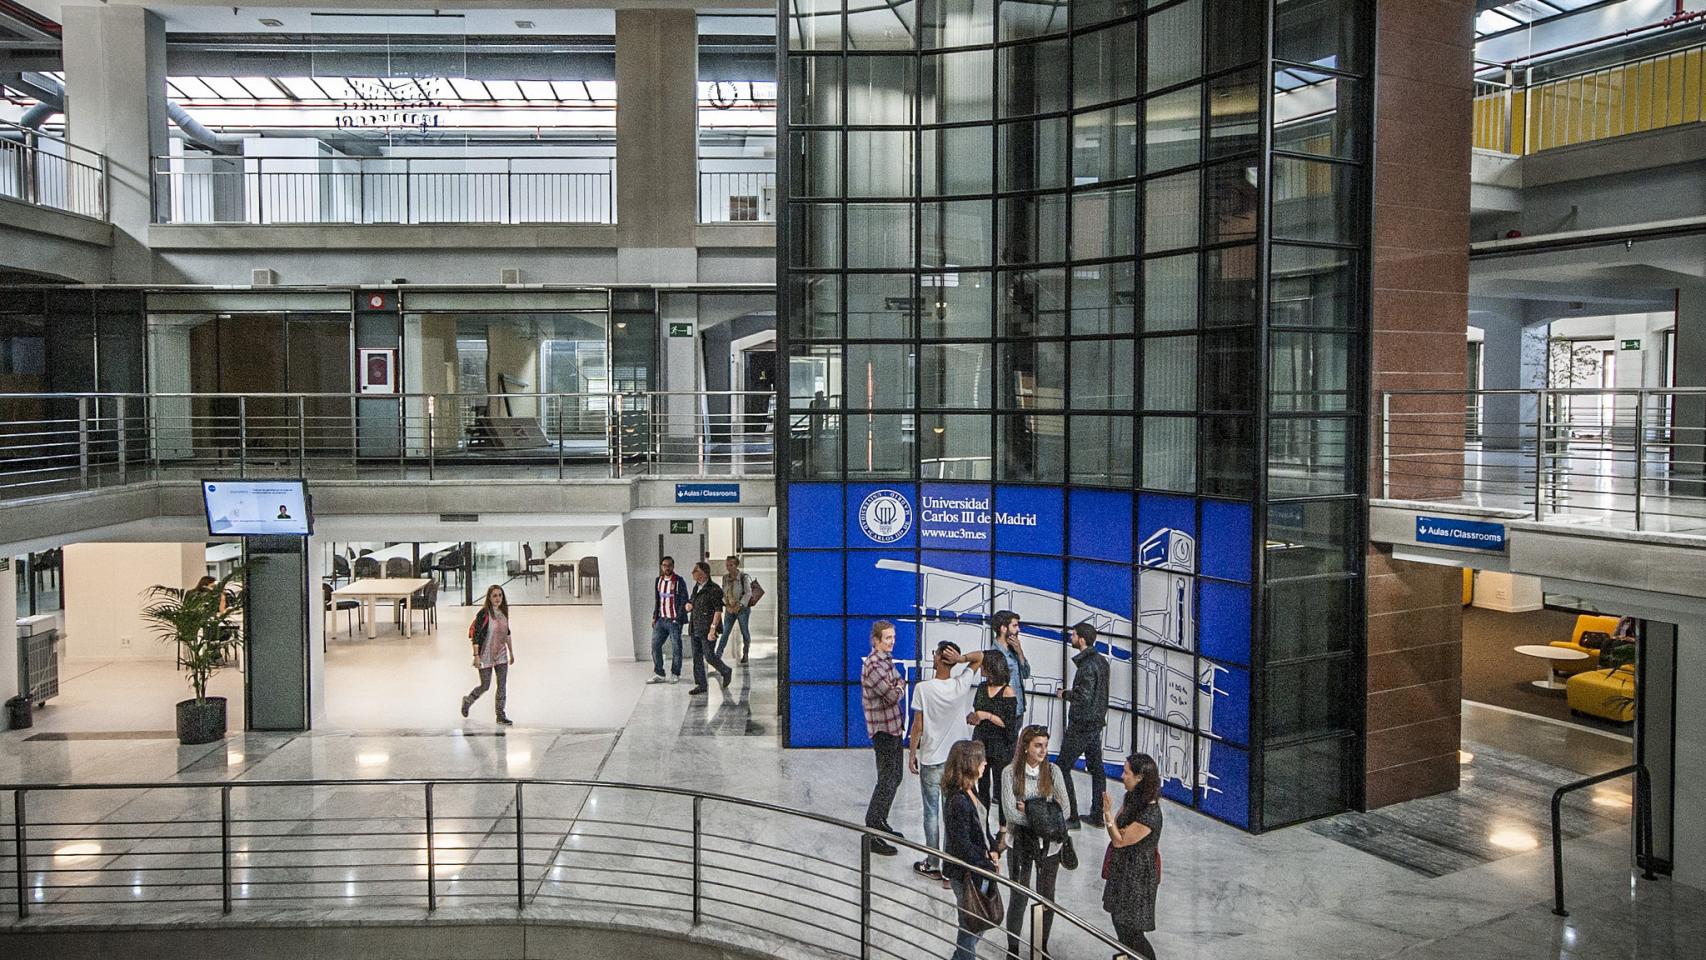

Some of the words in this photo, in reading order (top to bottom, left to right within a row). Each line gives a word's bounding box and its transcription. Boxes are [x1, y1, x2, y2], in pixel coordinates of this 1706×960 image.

[922, 496, 989, 510] Universidad
[921, 510, 959, 522] Carlos
[961, 511, 975, 523] III
[977, 512, 992, 524] de
[995, 512, 1037, 526] Madrid
[921, 528, 987, 539] www.uc3m.es
[1427, 526, 1449, 537] Aulas
[1453, 529, 1502, 542] Classrooms
